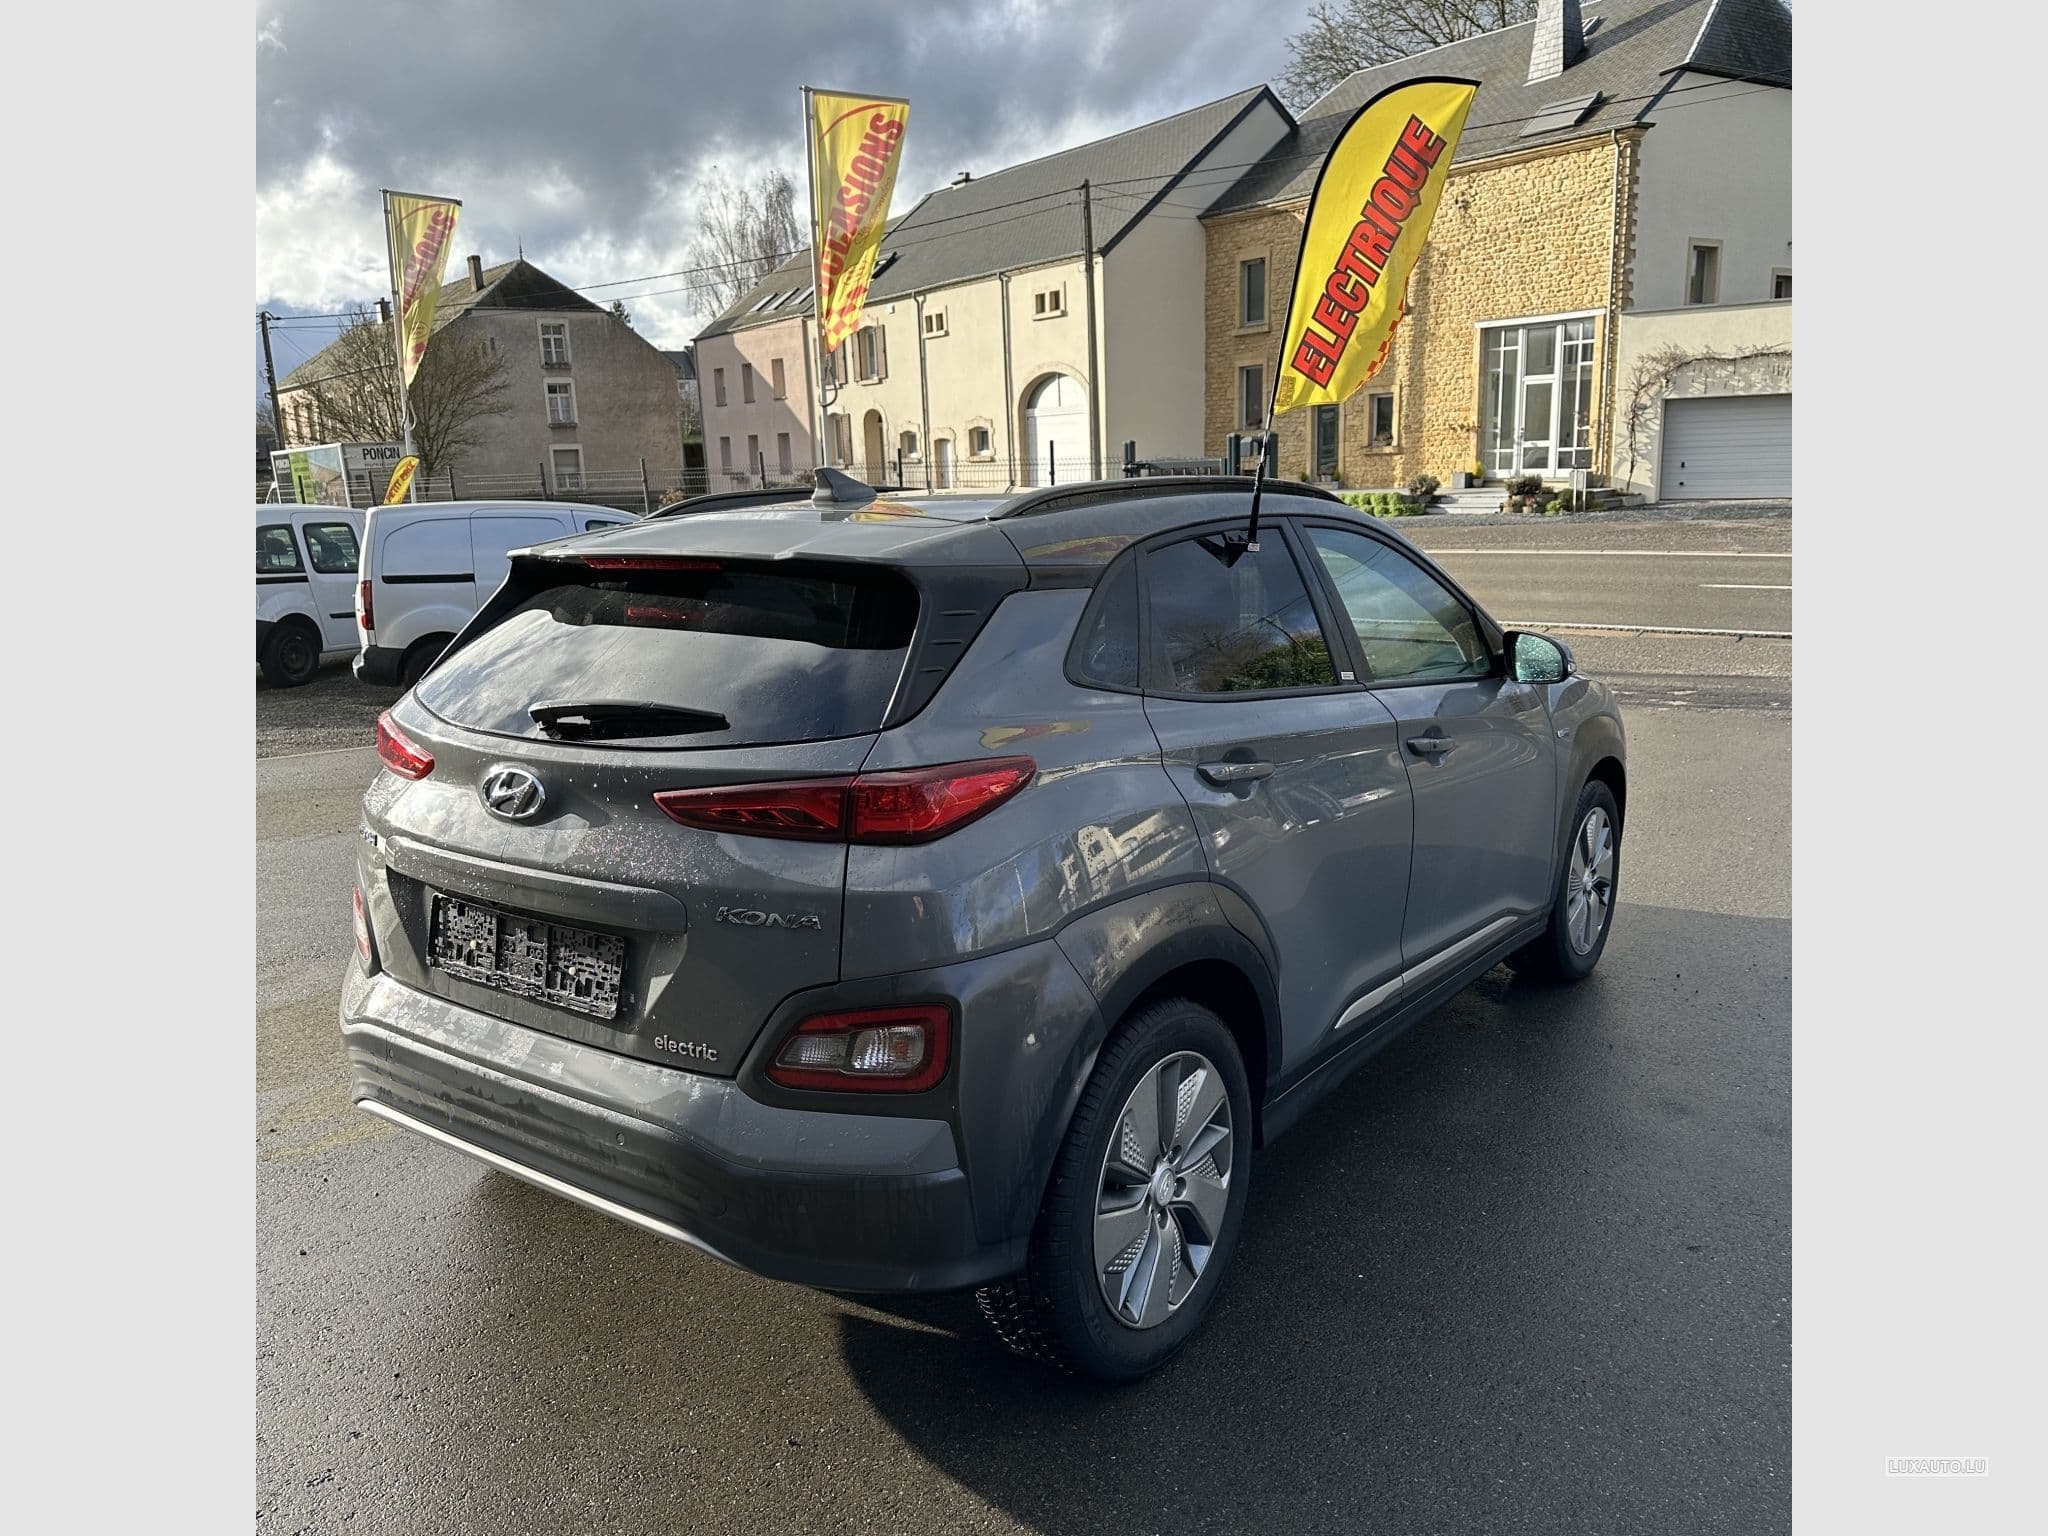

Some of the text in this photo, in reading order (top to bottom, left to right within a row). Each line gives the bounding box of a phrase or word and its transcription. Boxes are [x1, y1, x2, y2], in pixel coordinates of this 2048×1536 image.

[1290, 113, 1447, 390] ELECTRIQUE
[363, 447, 401, 460] PONCIN
[715, 906, 822, 930] KONA
[654, 1034, 718, 1062] electric
